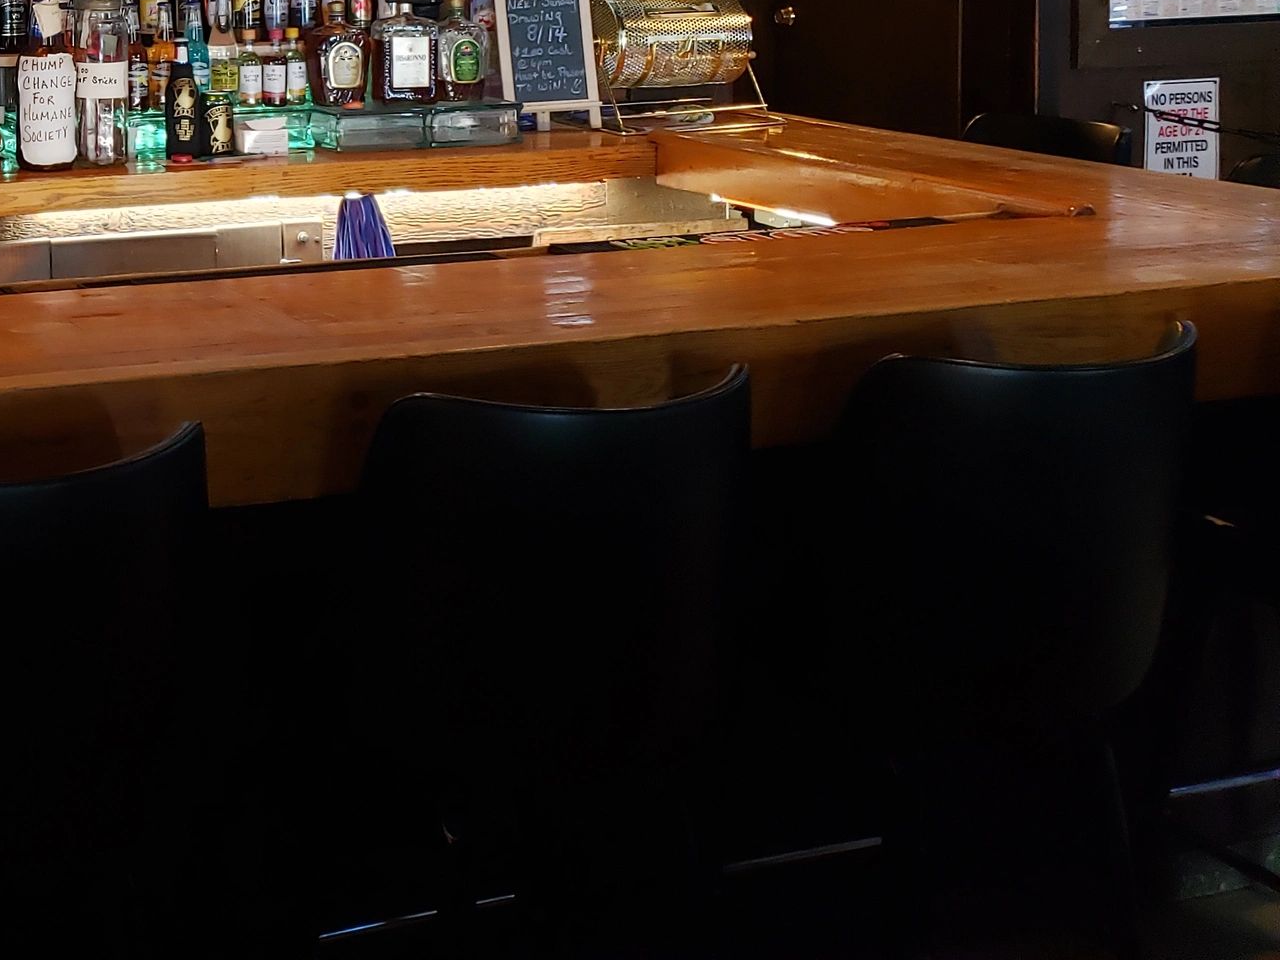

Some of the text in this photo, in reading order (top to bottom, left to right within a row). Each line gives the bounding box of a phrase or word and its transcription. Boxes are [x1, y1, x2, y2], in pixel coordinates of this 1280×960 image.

[527, 24, 568, 44] 8/14
[21, 58, 64, 72] CHUMP
[23, 76, 73, 90] CHANGE
[33, 92, 55, 105] FOR
[1152, 91, 1213, 106] NO PERSONS
[23, 104, 72, 122] HUMANE
[1191, 107, 1209, 119] THE
[22, 125, 68, 143] SOCIETY
[1158, 125, 1178, 137] AGE
[1155, 140, 1208, 154] PERMITTED
[1164, 156, 1199, 169] IN THIS
